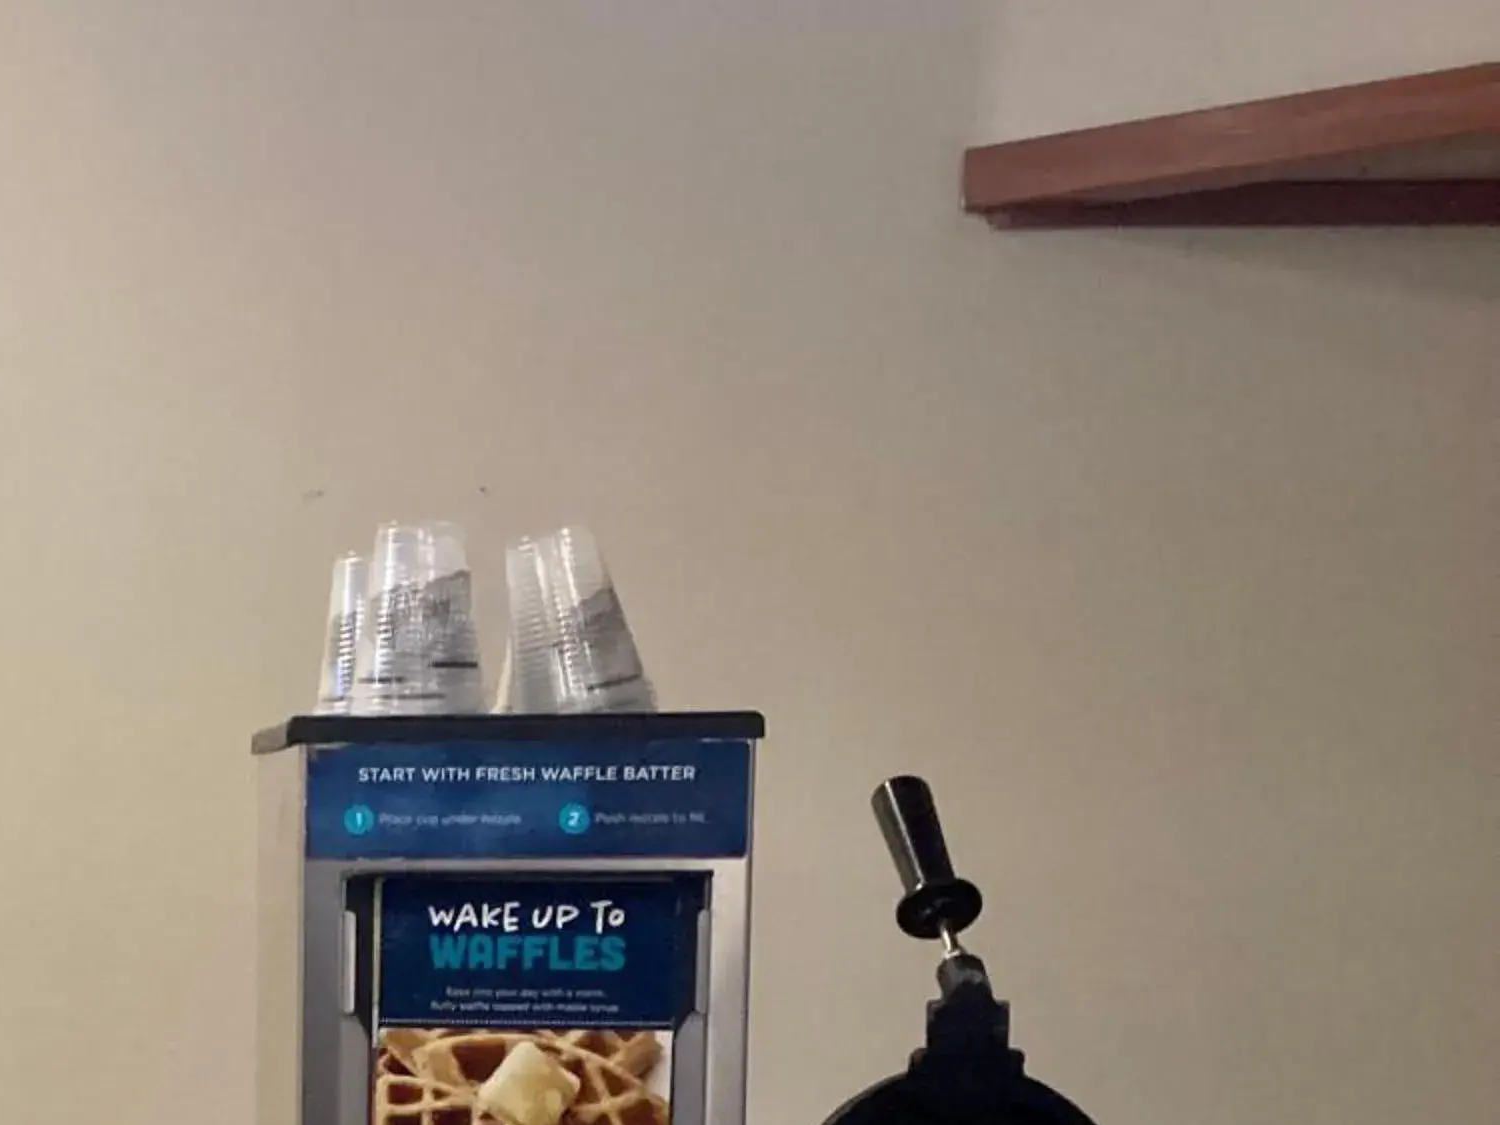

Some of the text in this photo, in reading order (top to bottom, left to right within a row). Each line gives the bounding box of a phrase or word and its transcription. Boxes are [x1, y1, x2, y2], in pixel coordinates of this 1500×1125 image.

[358, 765, 696, 782] START WITH FRESH WAFFLE BATTER
[428, 901, 520, 933] WAKE
[532, 904, 581, 930] UP
[429, 933, 627, 971] WAFFLES
